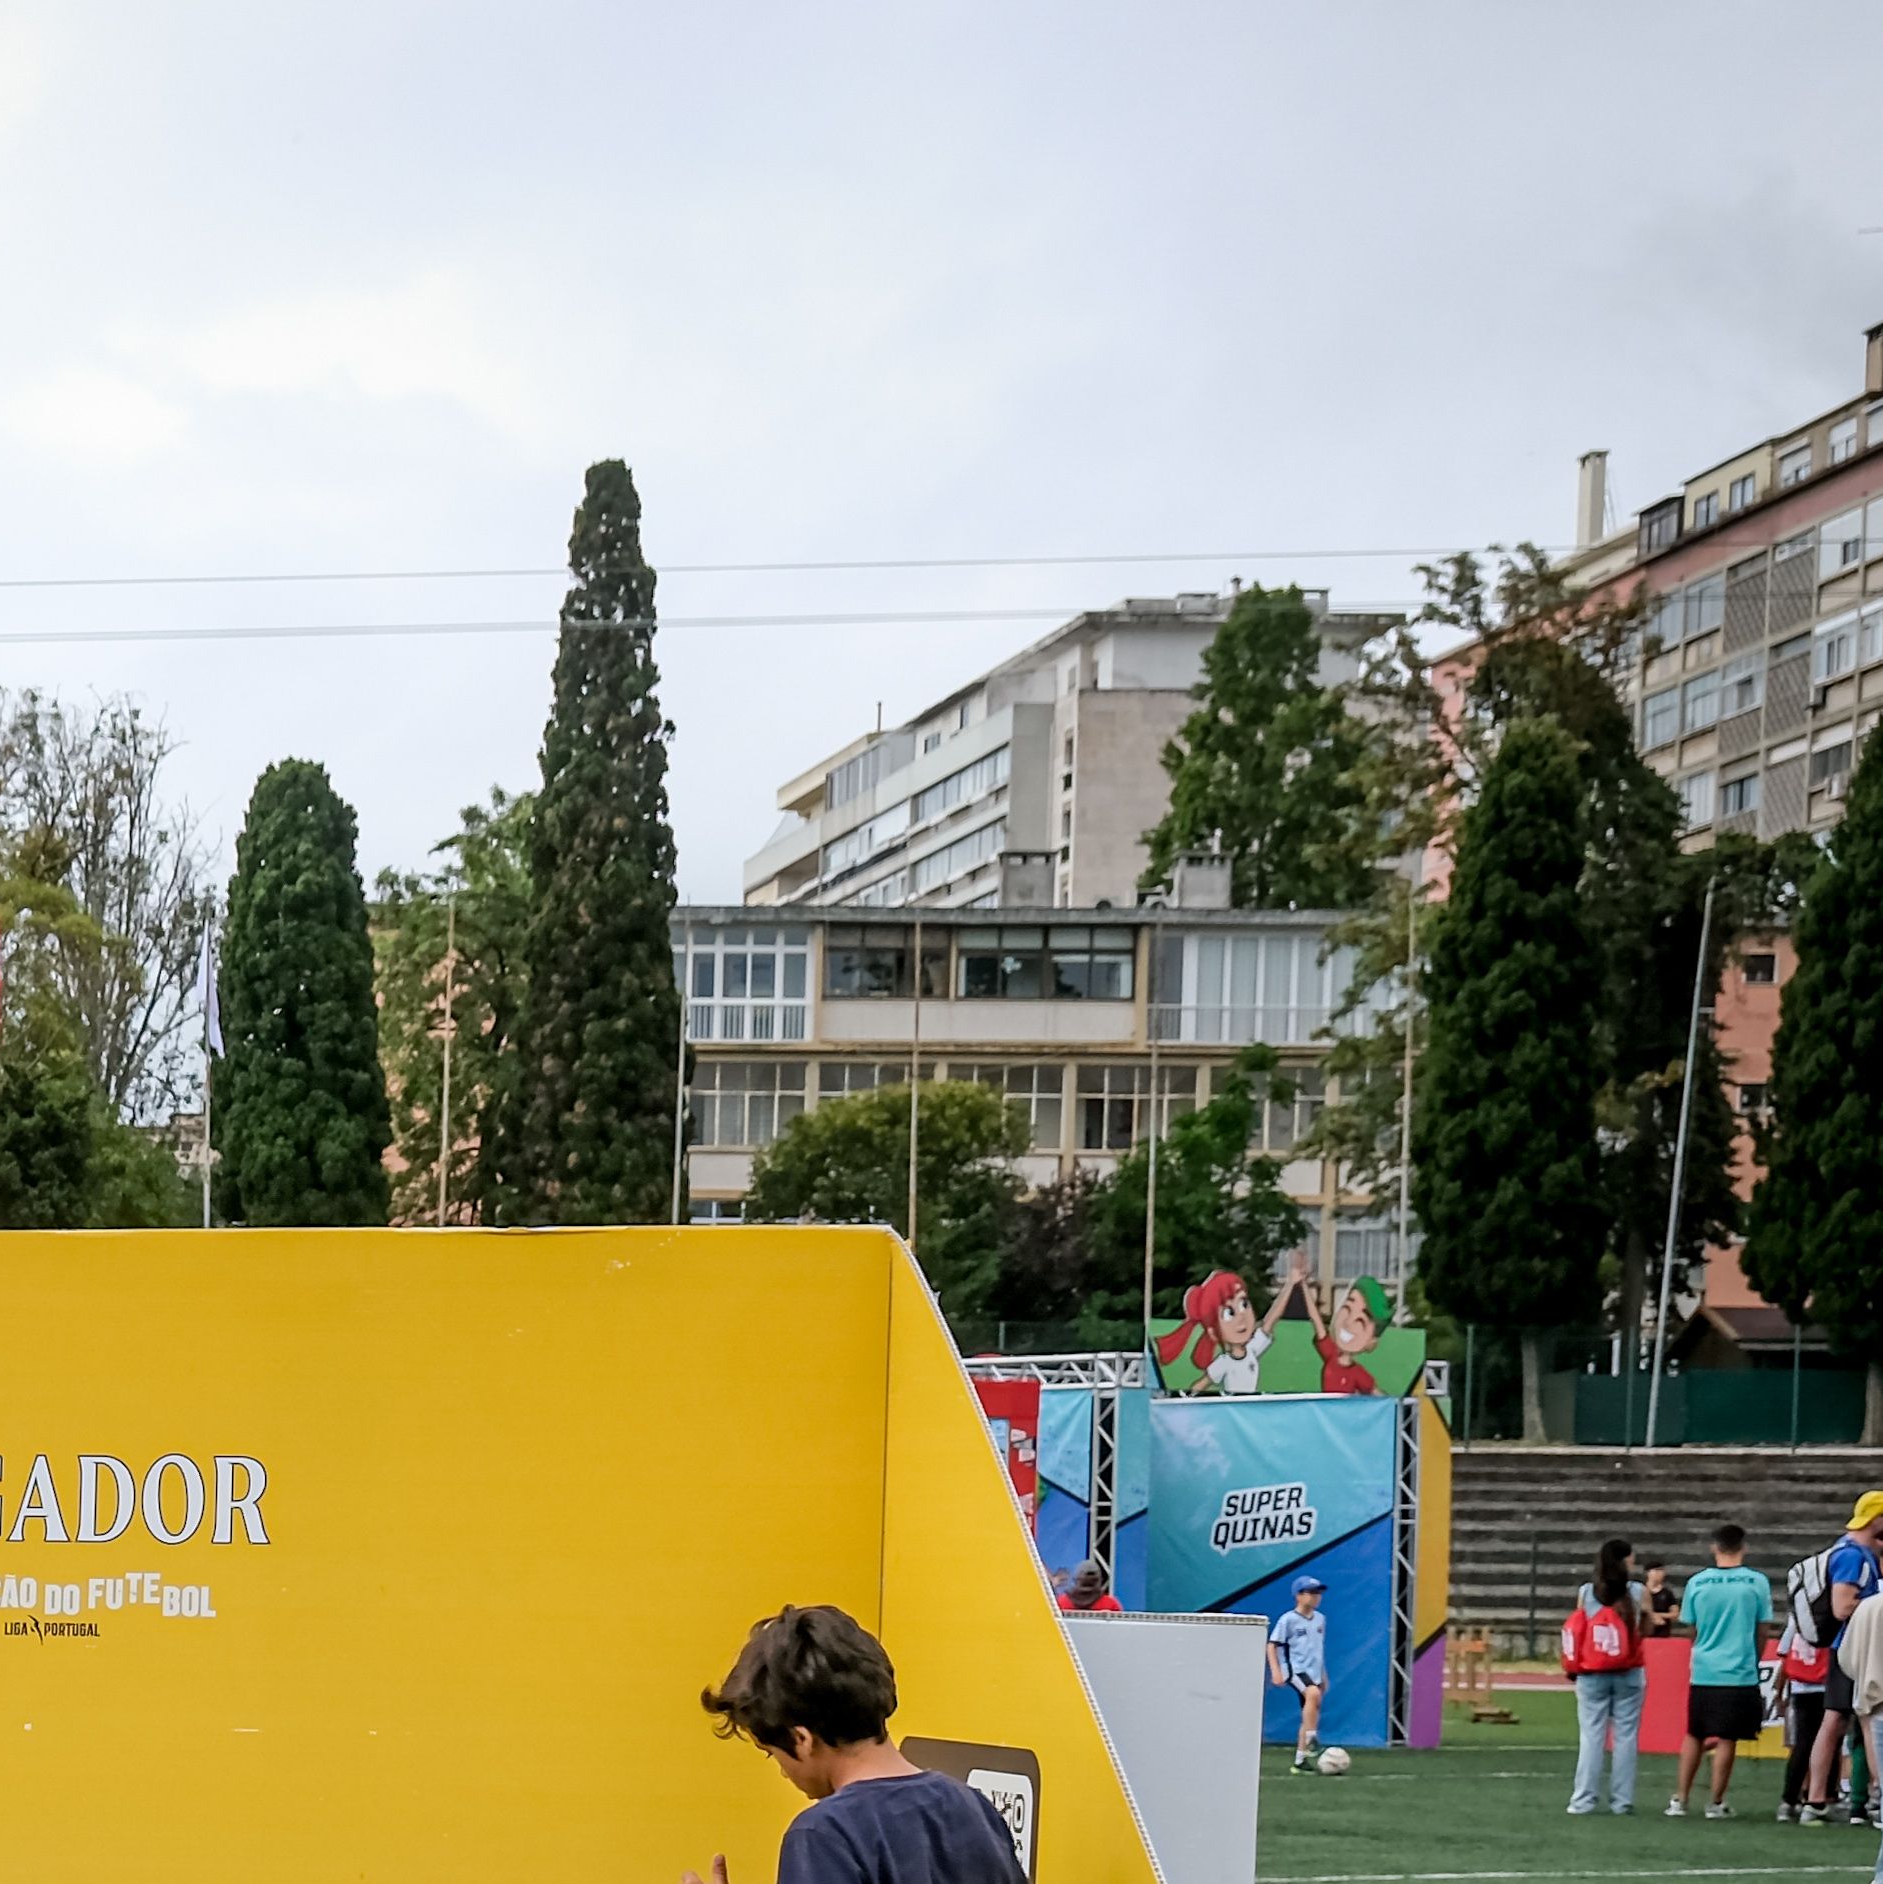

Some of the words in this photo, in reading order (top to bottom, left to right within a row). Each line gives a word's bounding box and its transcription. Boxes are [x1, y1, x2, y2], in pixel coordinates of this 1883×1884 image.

[1225, 1486, 1303, 1517] SUPER
[1213, 1511, 1313, 1550] QUINAS
[44, 1584, 81, 1615] DO
[87, 1572, 217, 1618] FUTEBOL
[4, 1621, 29, 1636] LIGA
[44, 1622, 100, 1637] PORTUGAL
